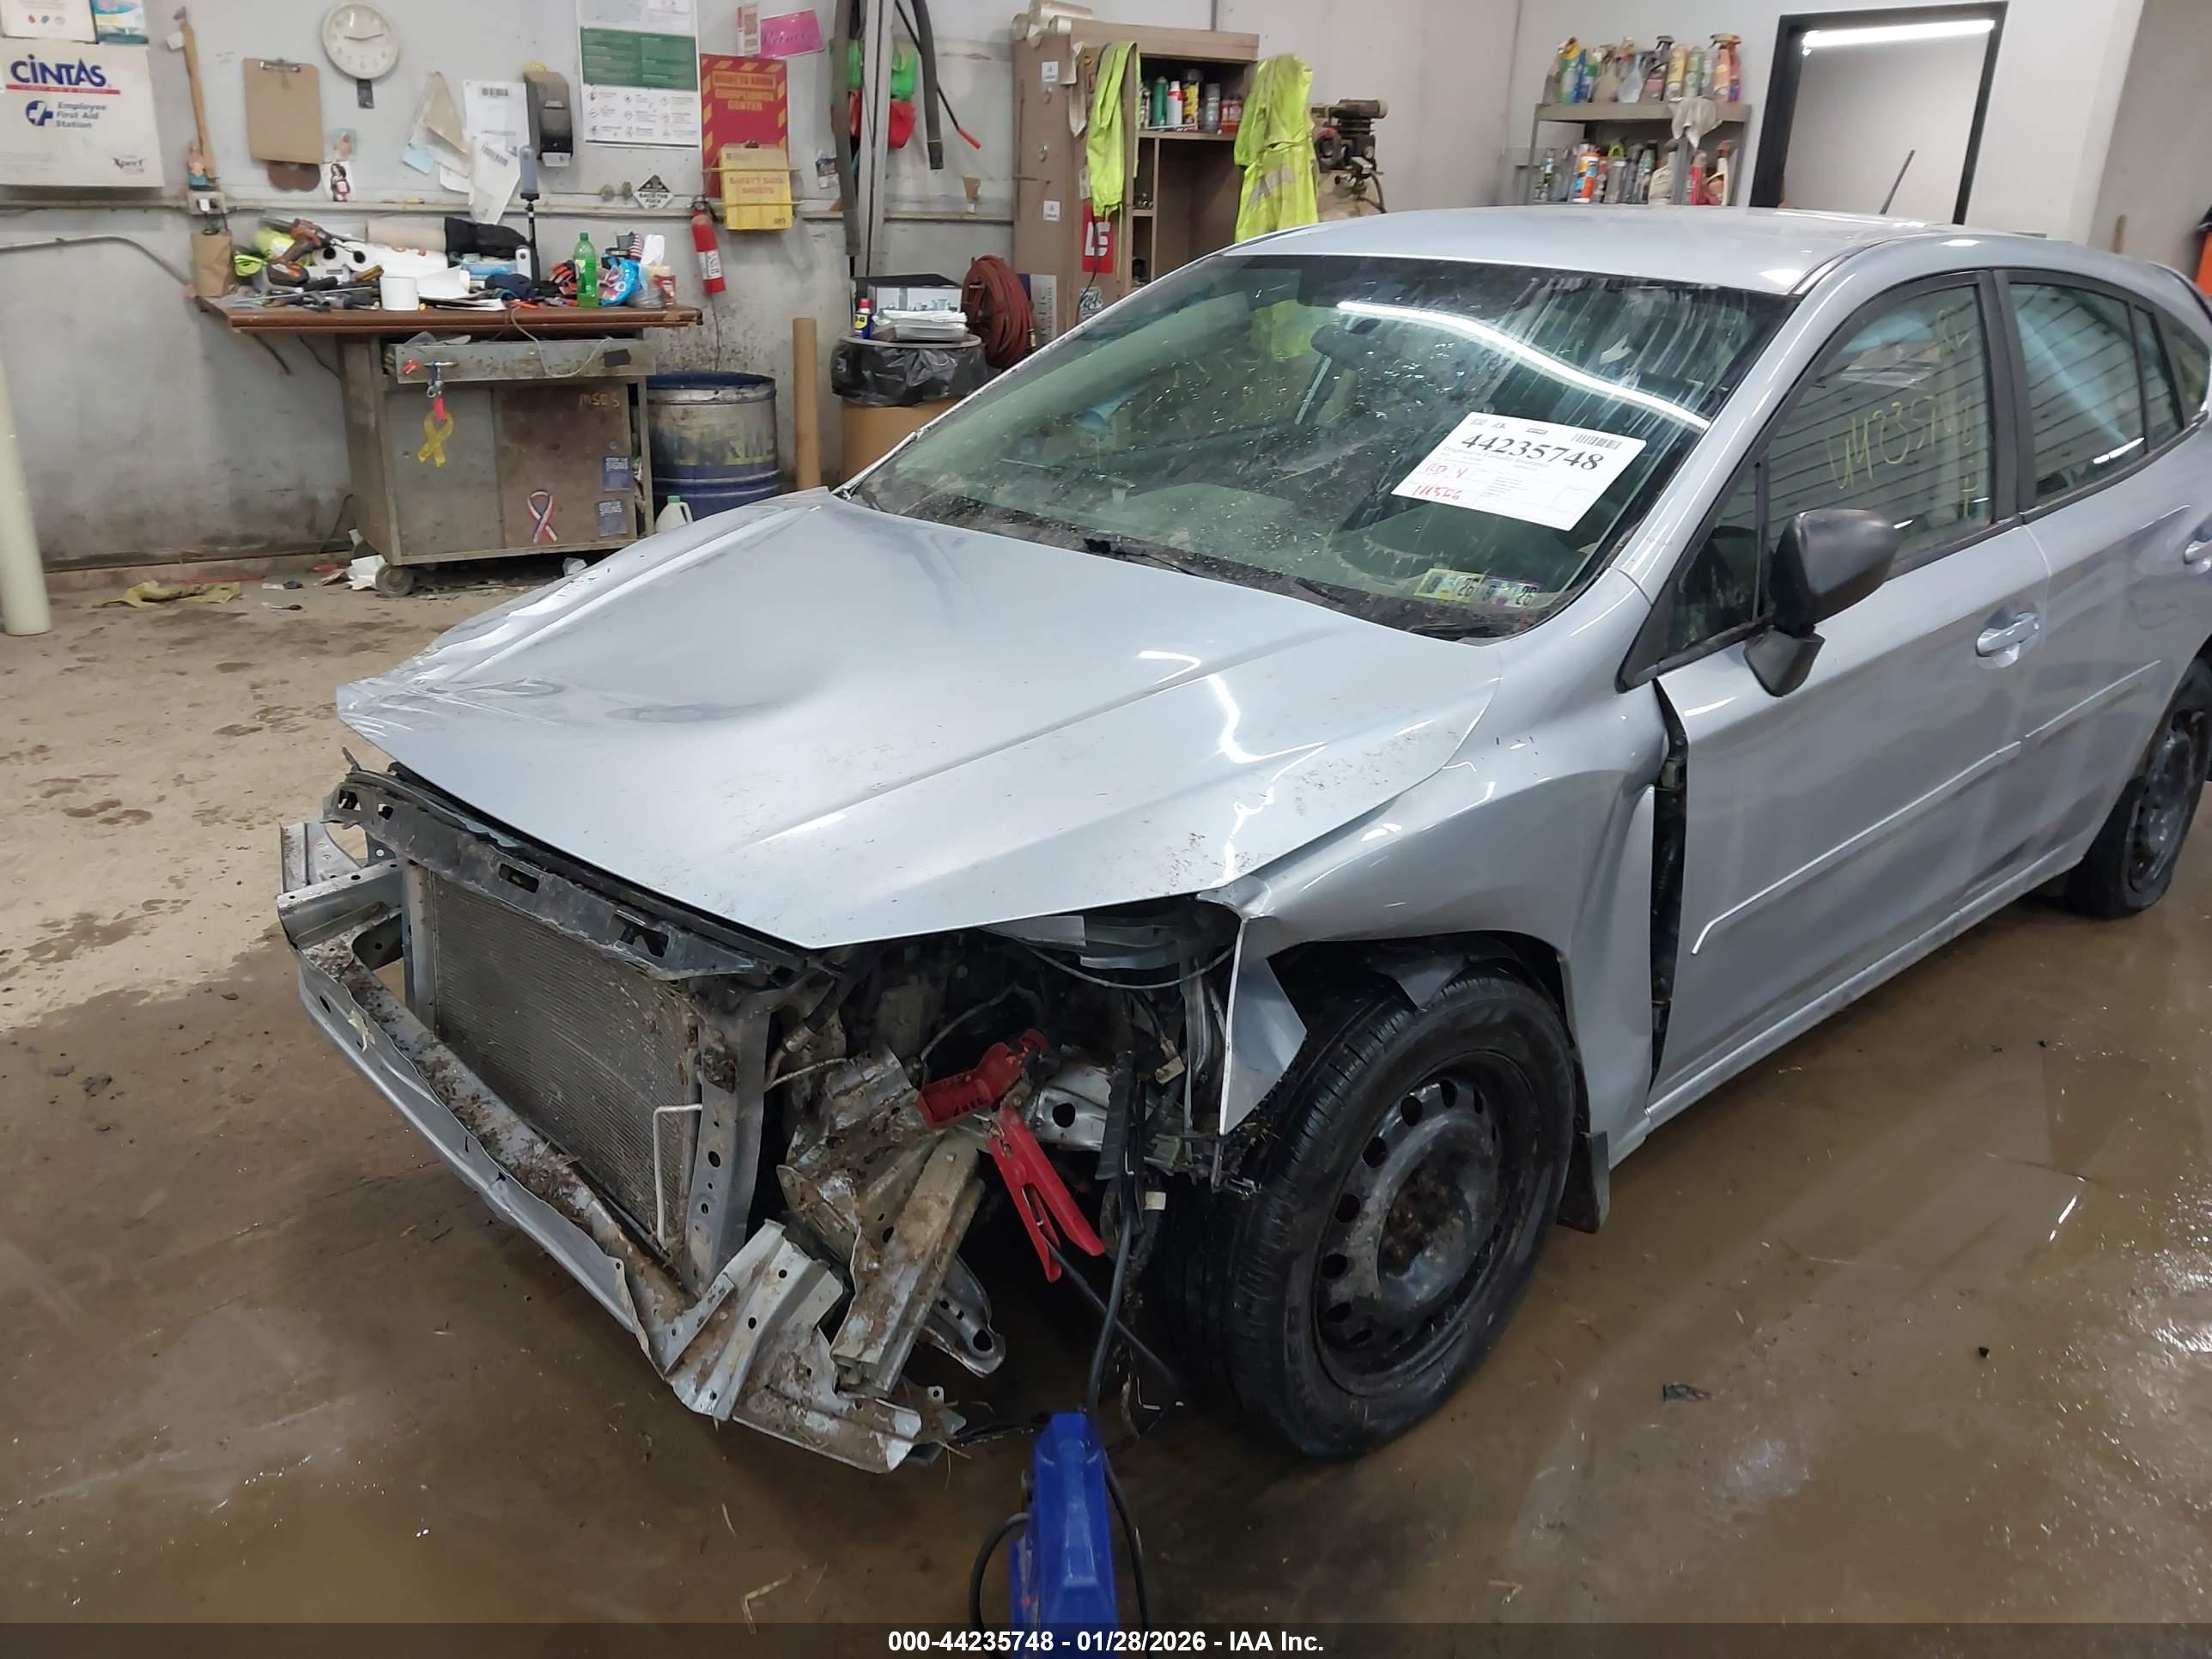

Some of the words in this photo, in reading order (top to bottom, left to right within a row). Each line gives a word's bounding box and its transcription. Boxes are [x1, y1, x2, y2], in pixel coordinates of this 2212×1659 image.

[57, 101, 107, 112] Employee
[56, 111, 79, 119] First
[56, 120, 93, 129] Station
[1462, 434, 1604, 471] 44235748
